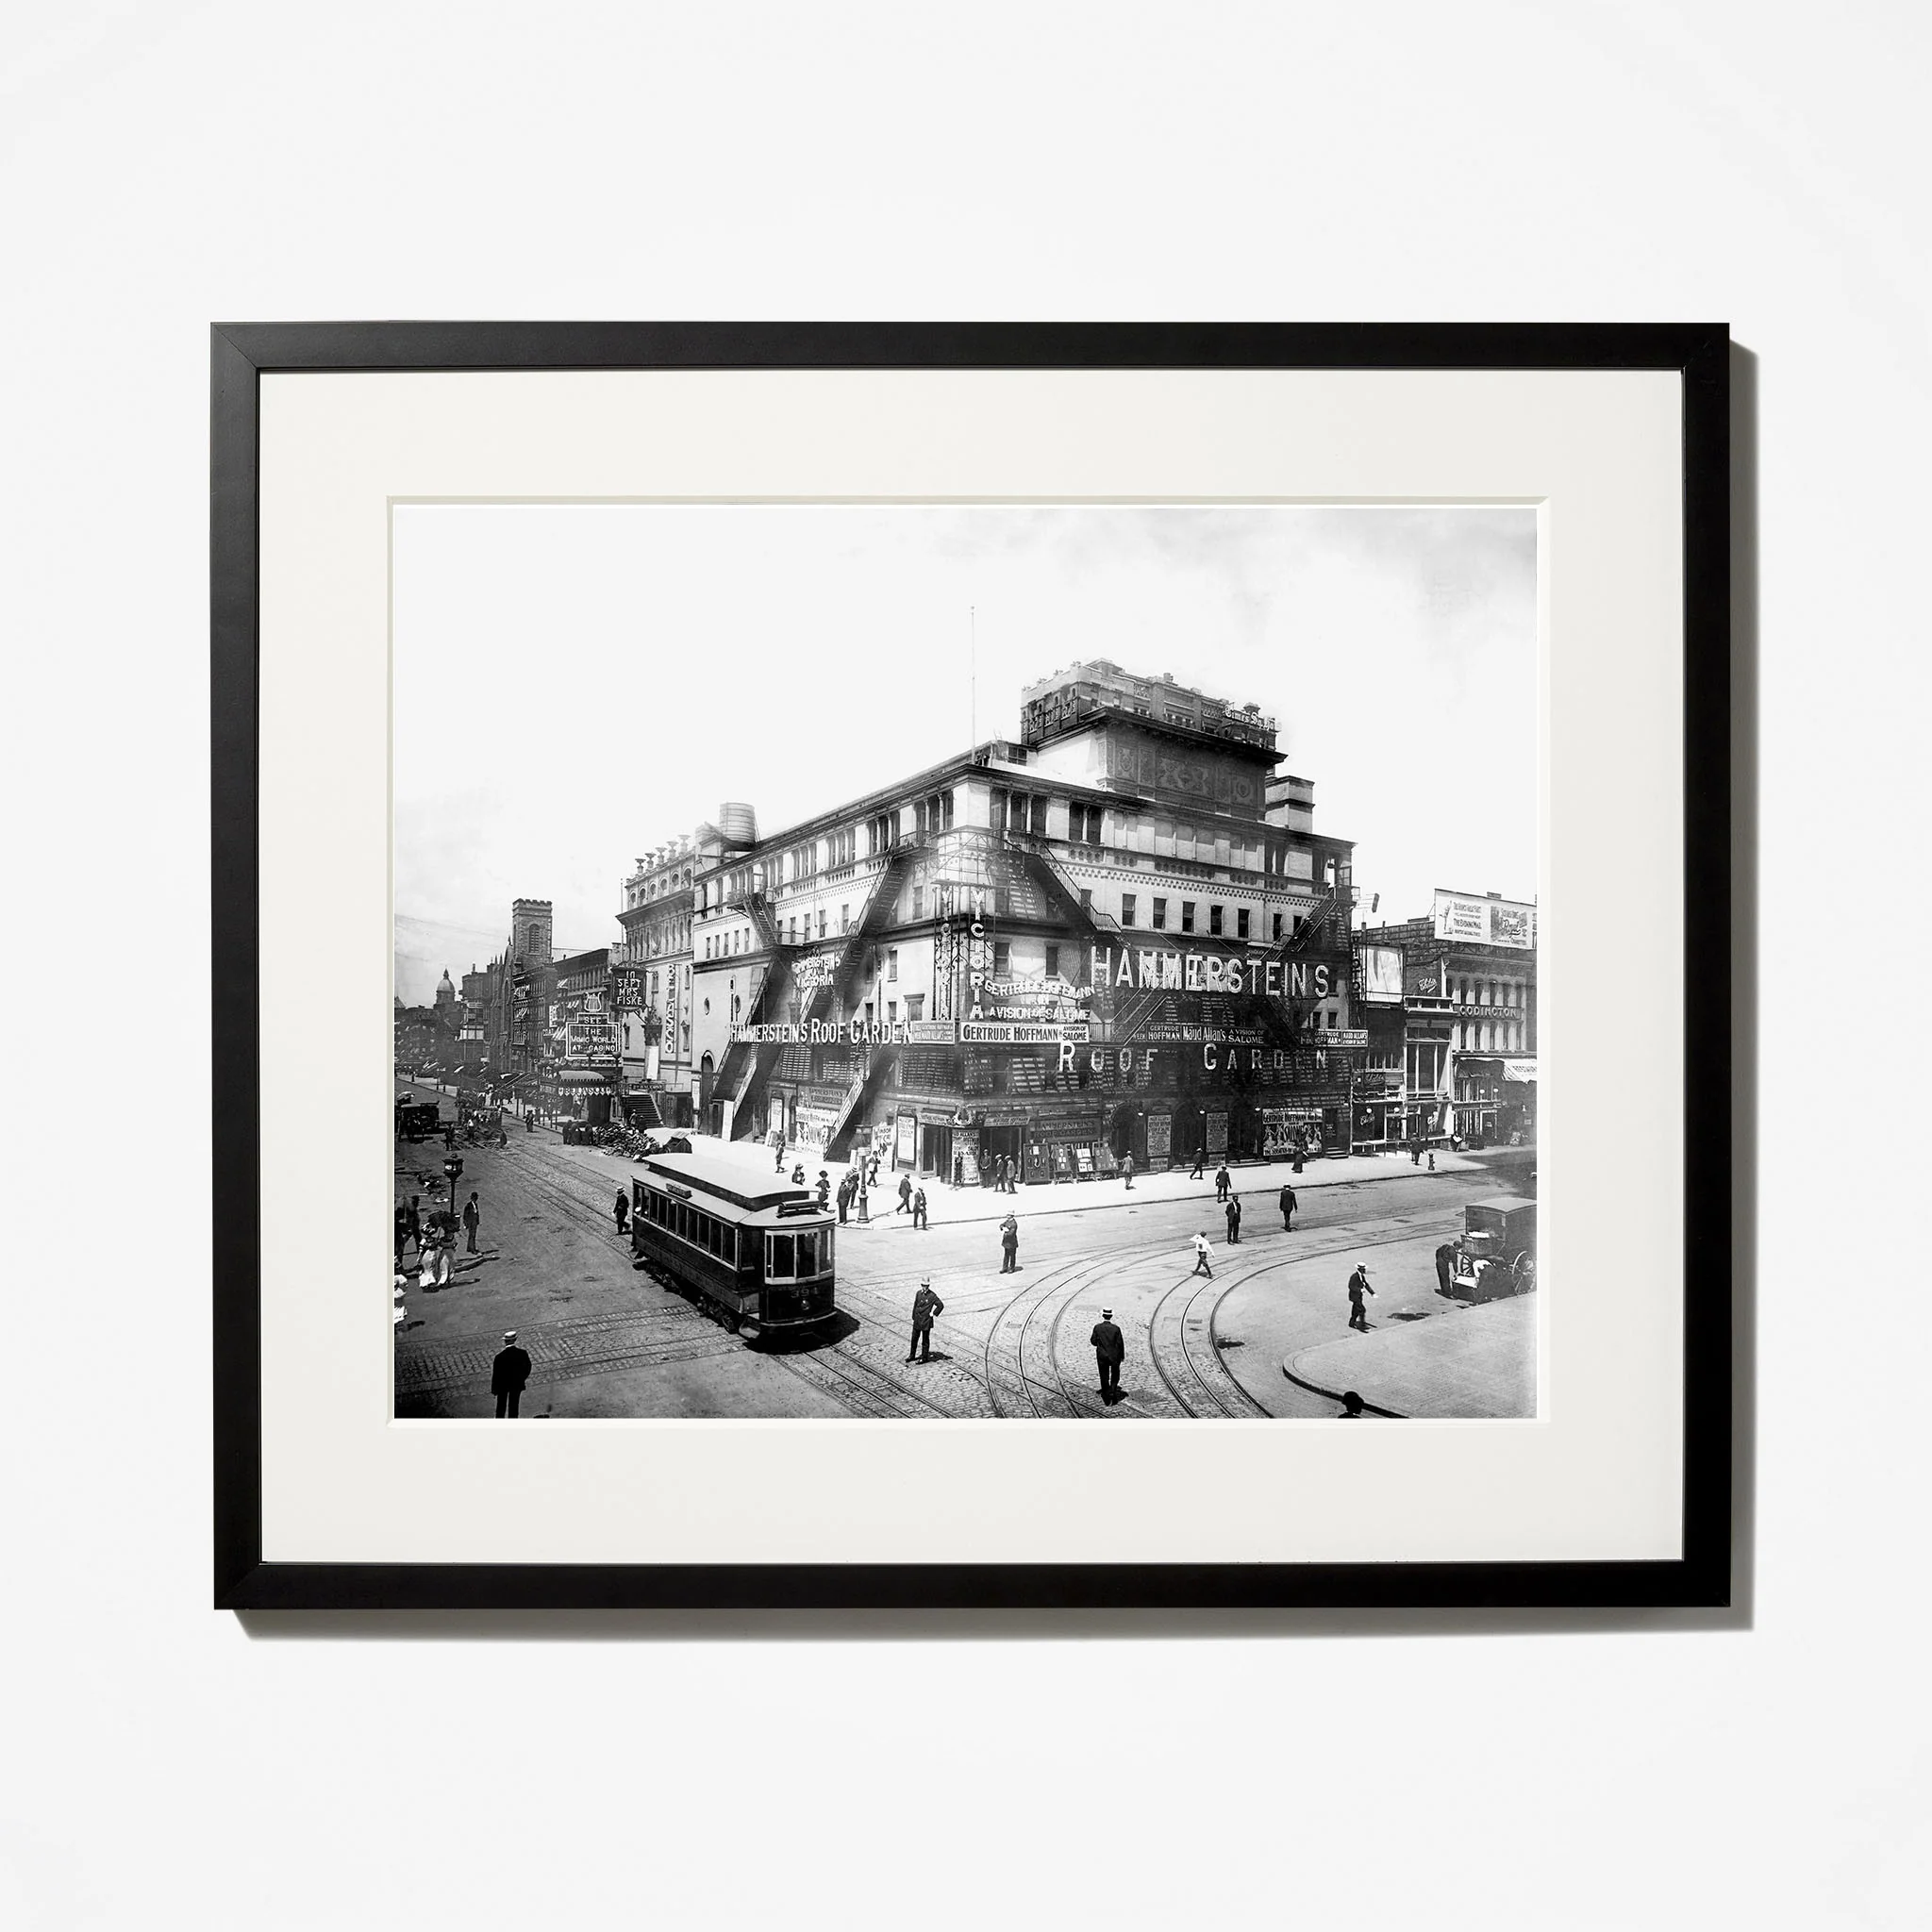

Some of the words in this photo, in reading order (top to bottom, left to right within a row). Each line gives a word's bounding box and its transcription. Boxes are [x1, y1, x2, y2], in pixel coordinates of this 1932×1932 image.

[968, 889, 986, 1020] VICTORIA
[617, 977, 641, 988] SEPT
[618, 987, 639, 997] MRS
[616, 996, 642, 1006] FISKE
[584, 1016, 602, 1024] SEE
[585, 1027, 603, 1036] THE
[811, 1018, 846, 1044] ROOF
[850, 1020, 913, 1045] GARDEN
[962, 1024, 1011, 1041] GERTRUDE
[1013, 1026, 1058, 1041] HOFFMANN
[1062, 1032, 1088, 1041] SALOME
[1148, 1031, 1181, 1041] HOFFMAN
[1182, 1025, 1202, 1041] Maud
[592, 1035, 616, 1043] WORLD
[1227, 1034, 1265, 1044] SALOME
[1058, 1040, 1158, 1074] ROOF
